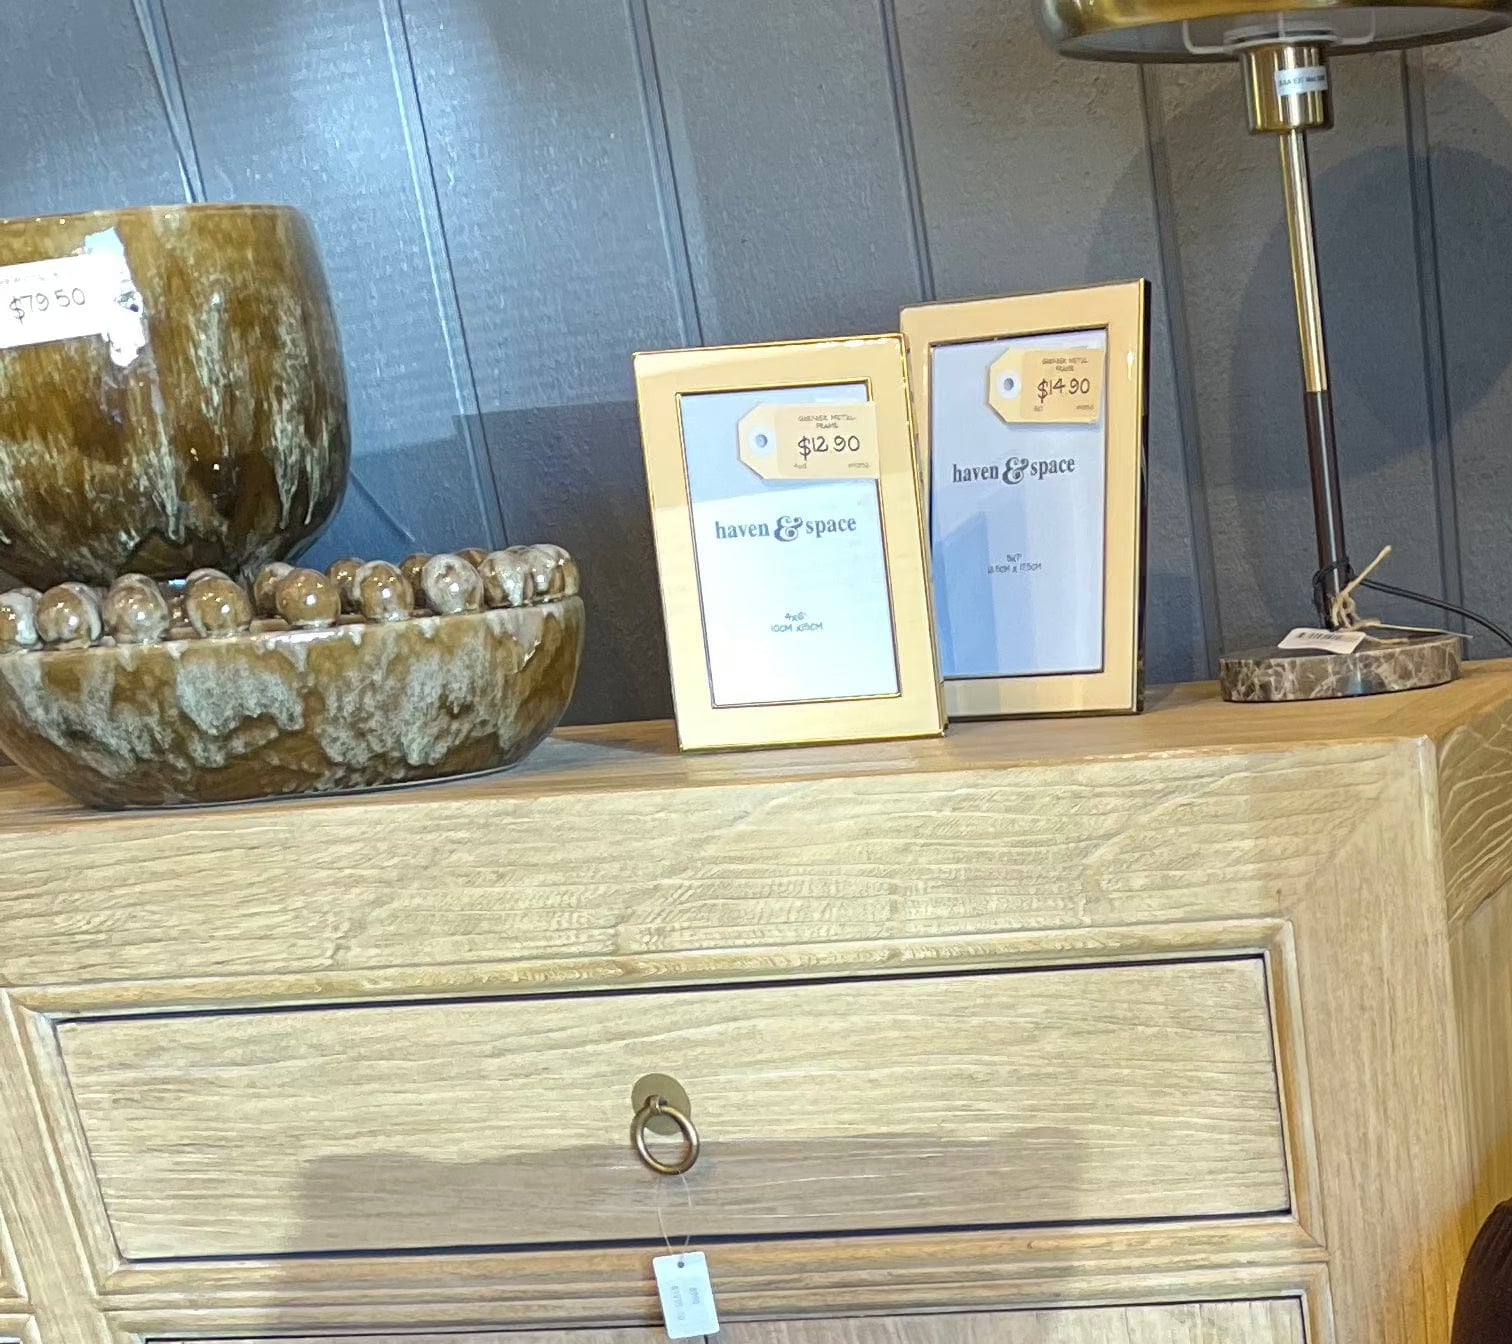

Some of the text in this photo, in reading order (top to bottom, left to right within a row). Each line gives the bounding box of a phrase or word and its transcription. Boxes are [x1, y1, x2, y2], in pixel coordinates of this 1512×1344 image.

[953, 457, 1076, 485] haven & space
[715, 515, 857, 542] haven & space
